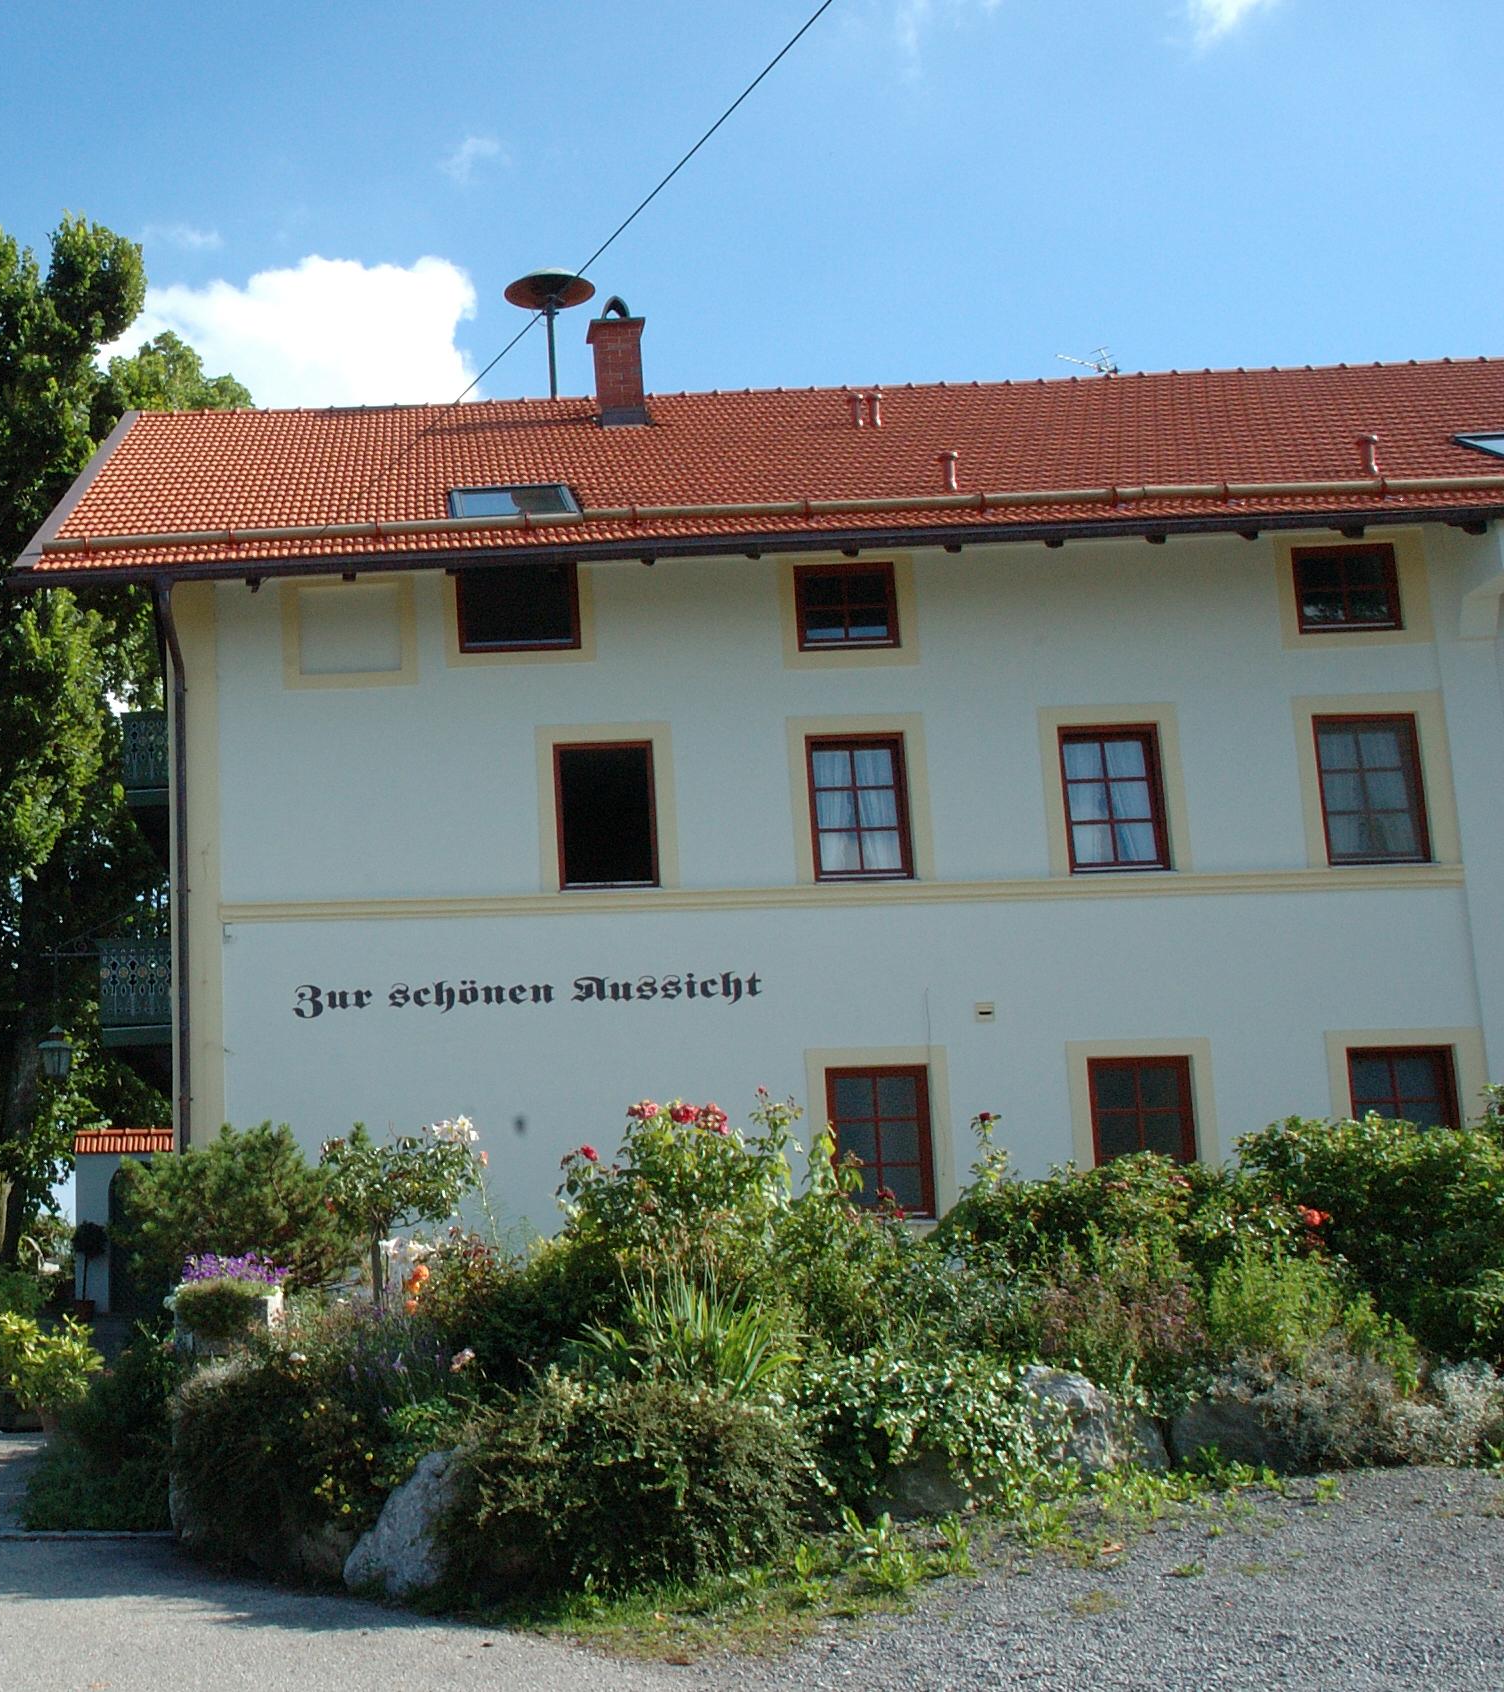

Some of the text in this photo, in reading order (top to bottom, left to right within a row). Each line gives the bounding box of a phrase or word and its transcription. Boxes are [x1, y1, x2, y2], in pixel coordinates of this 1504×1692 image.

[292, 970, 762, 1019] Zur schönen Aussicht
